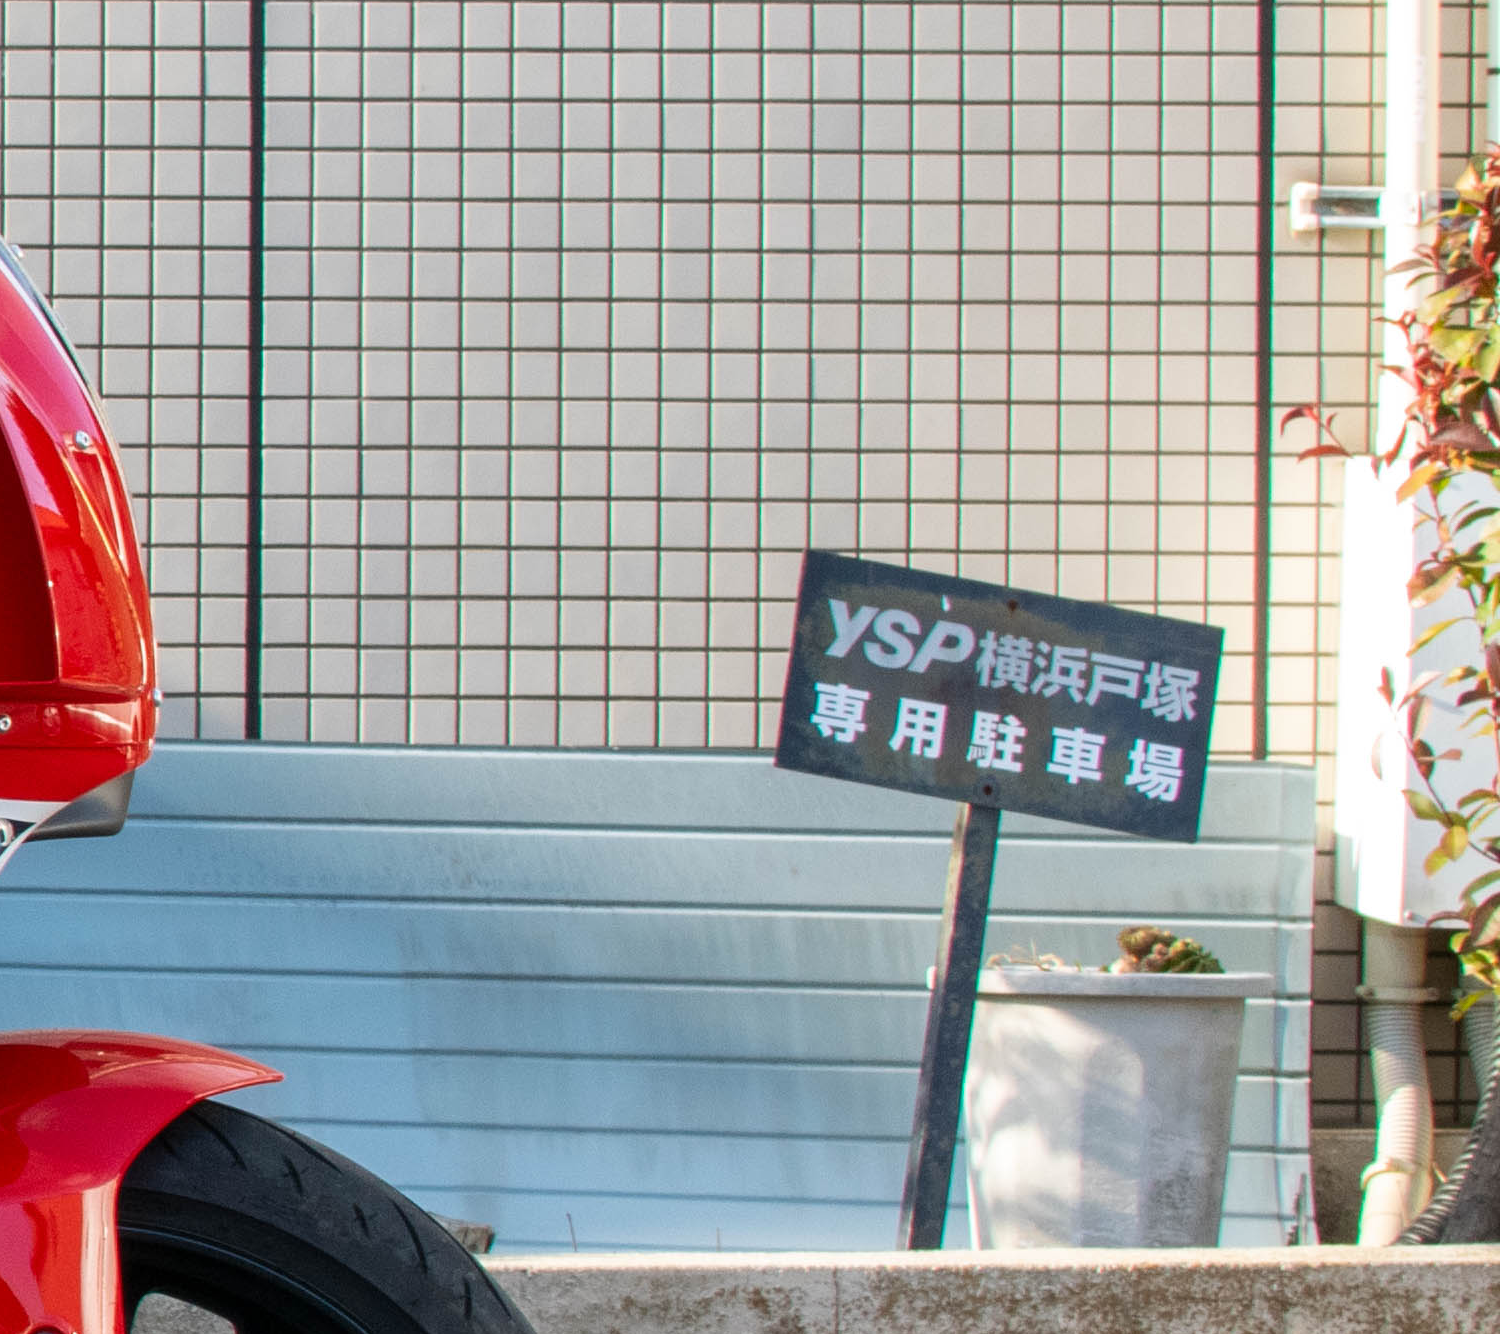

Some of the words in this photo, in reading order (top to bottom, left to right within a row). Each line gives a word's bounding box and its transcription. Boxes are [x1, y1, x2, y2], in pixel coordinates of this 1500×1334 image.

[810, 682, 1185, 803] 専用駐車場
